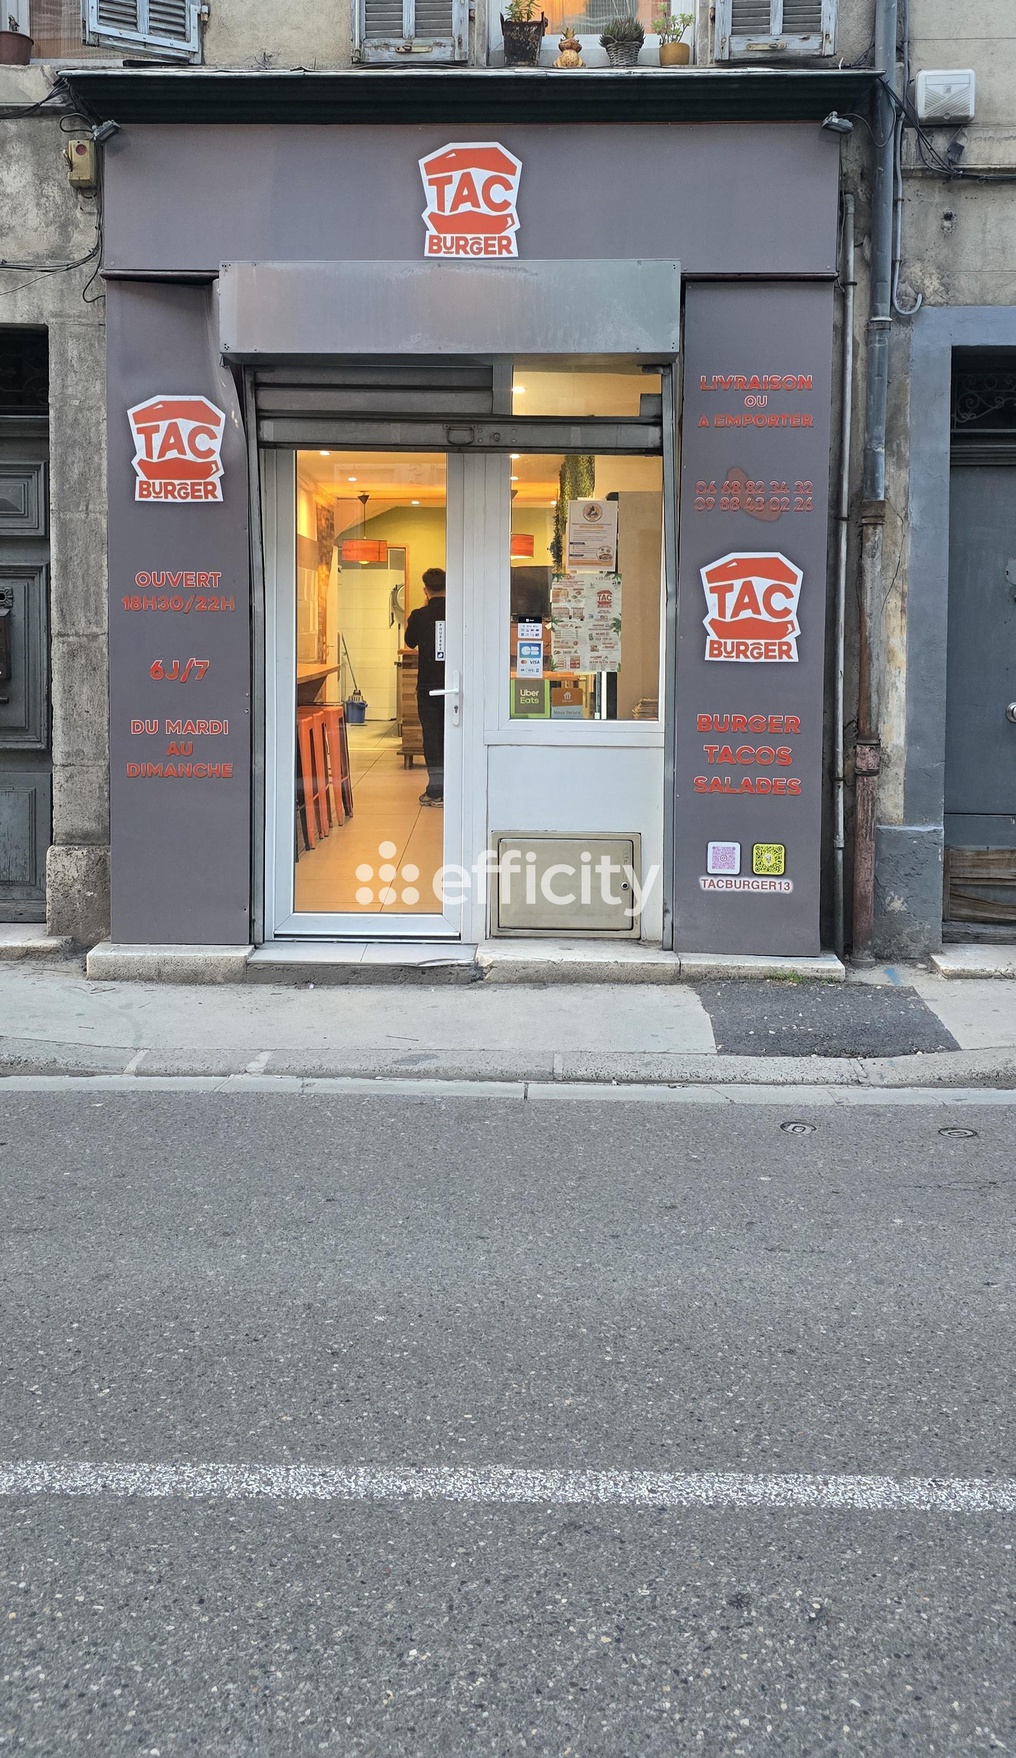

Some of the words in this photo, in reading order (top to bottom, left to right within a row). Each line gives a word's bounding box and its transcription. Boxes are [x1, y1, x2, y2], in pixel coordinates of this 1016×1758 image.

[427, 171, 514, 213] TAC
[427, 234, 514, 256] BURGER
[700, 374, 813, 391] LIVRAISON
[744, 395, 768, 408] OU
[698, 416, 710, 428] A
[714, 413, 814, 428] EMPORTER
[136, 421, 218, 460] TAC
[138, 480, 219, 500] BURGER
[695, 480, 717, 495] 06
[720, 480, 741, 495] 68
[745, 480, 765, 495] 82
[769, 480, 790, 495] 34
[794, 480, 813, 495] 32
[694, 496, 716, 512] 09
[719, 496, 741, 512] 88
[744, 496, 765, 512] 43
[769, 496, 790, 512] 02
[794, 496, 814, 512] 26
[134, 570, 222, 588] OUVERT
[121, 594, 236, 614] 18H30/22H
[708, 579, 794, 620] TAC
[708, 639, 794, 660] BURGER
[149, 657, 210, 683] 6J/7
[520, 688, 540, 697] Uber
[520, 696, 540, 704] Eats
[130, 719, 159, 735] DU
[165, 719, 229, 735] MARDI
[696, 713, 801, 734] BURGER
[165, 741, 194, 757] AU
[703, 744, 793, 766] TACOS
[126, 762, 234, 779] DIMANCHE
[693, 775, 802, 796] SALADES
[700, 878, 791, 891] TACBURGER13
